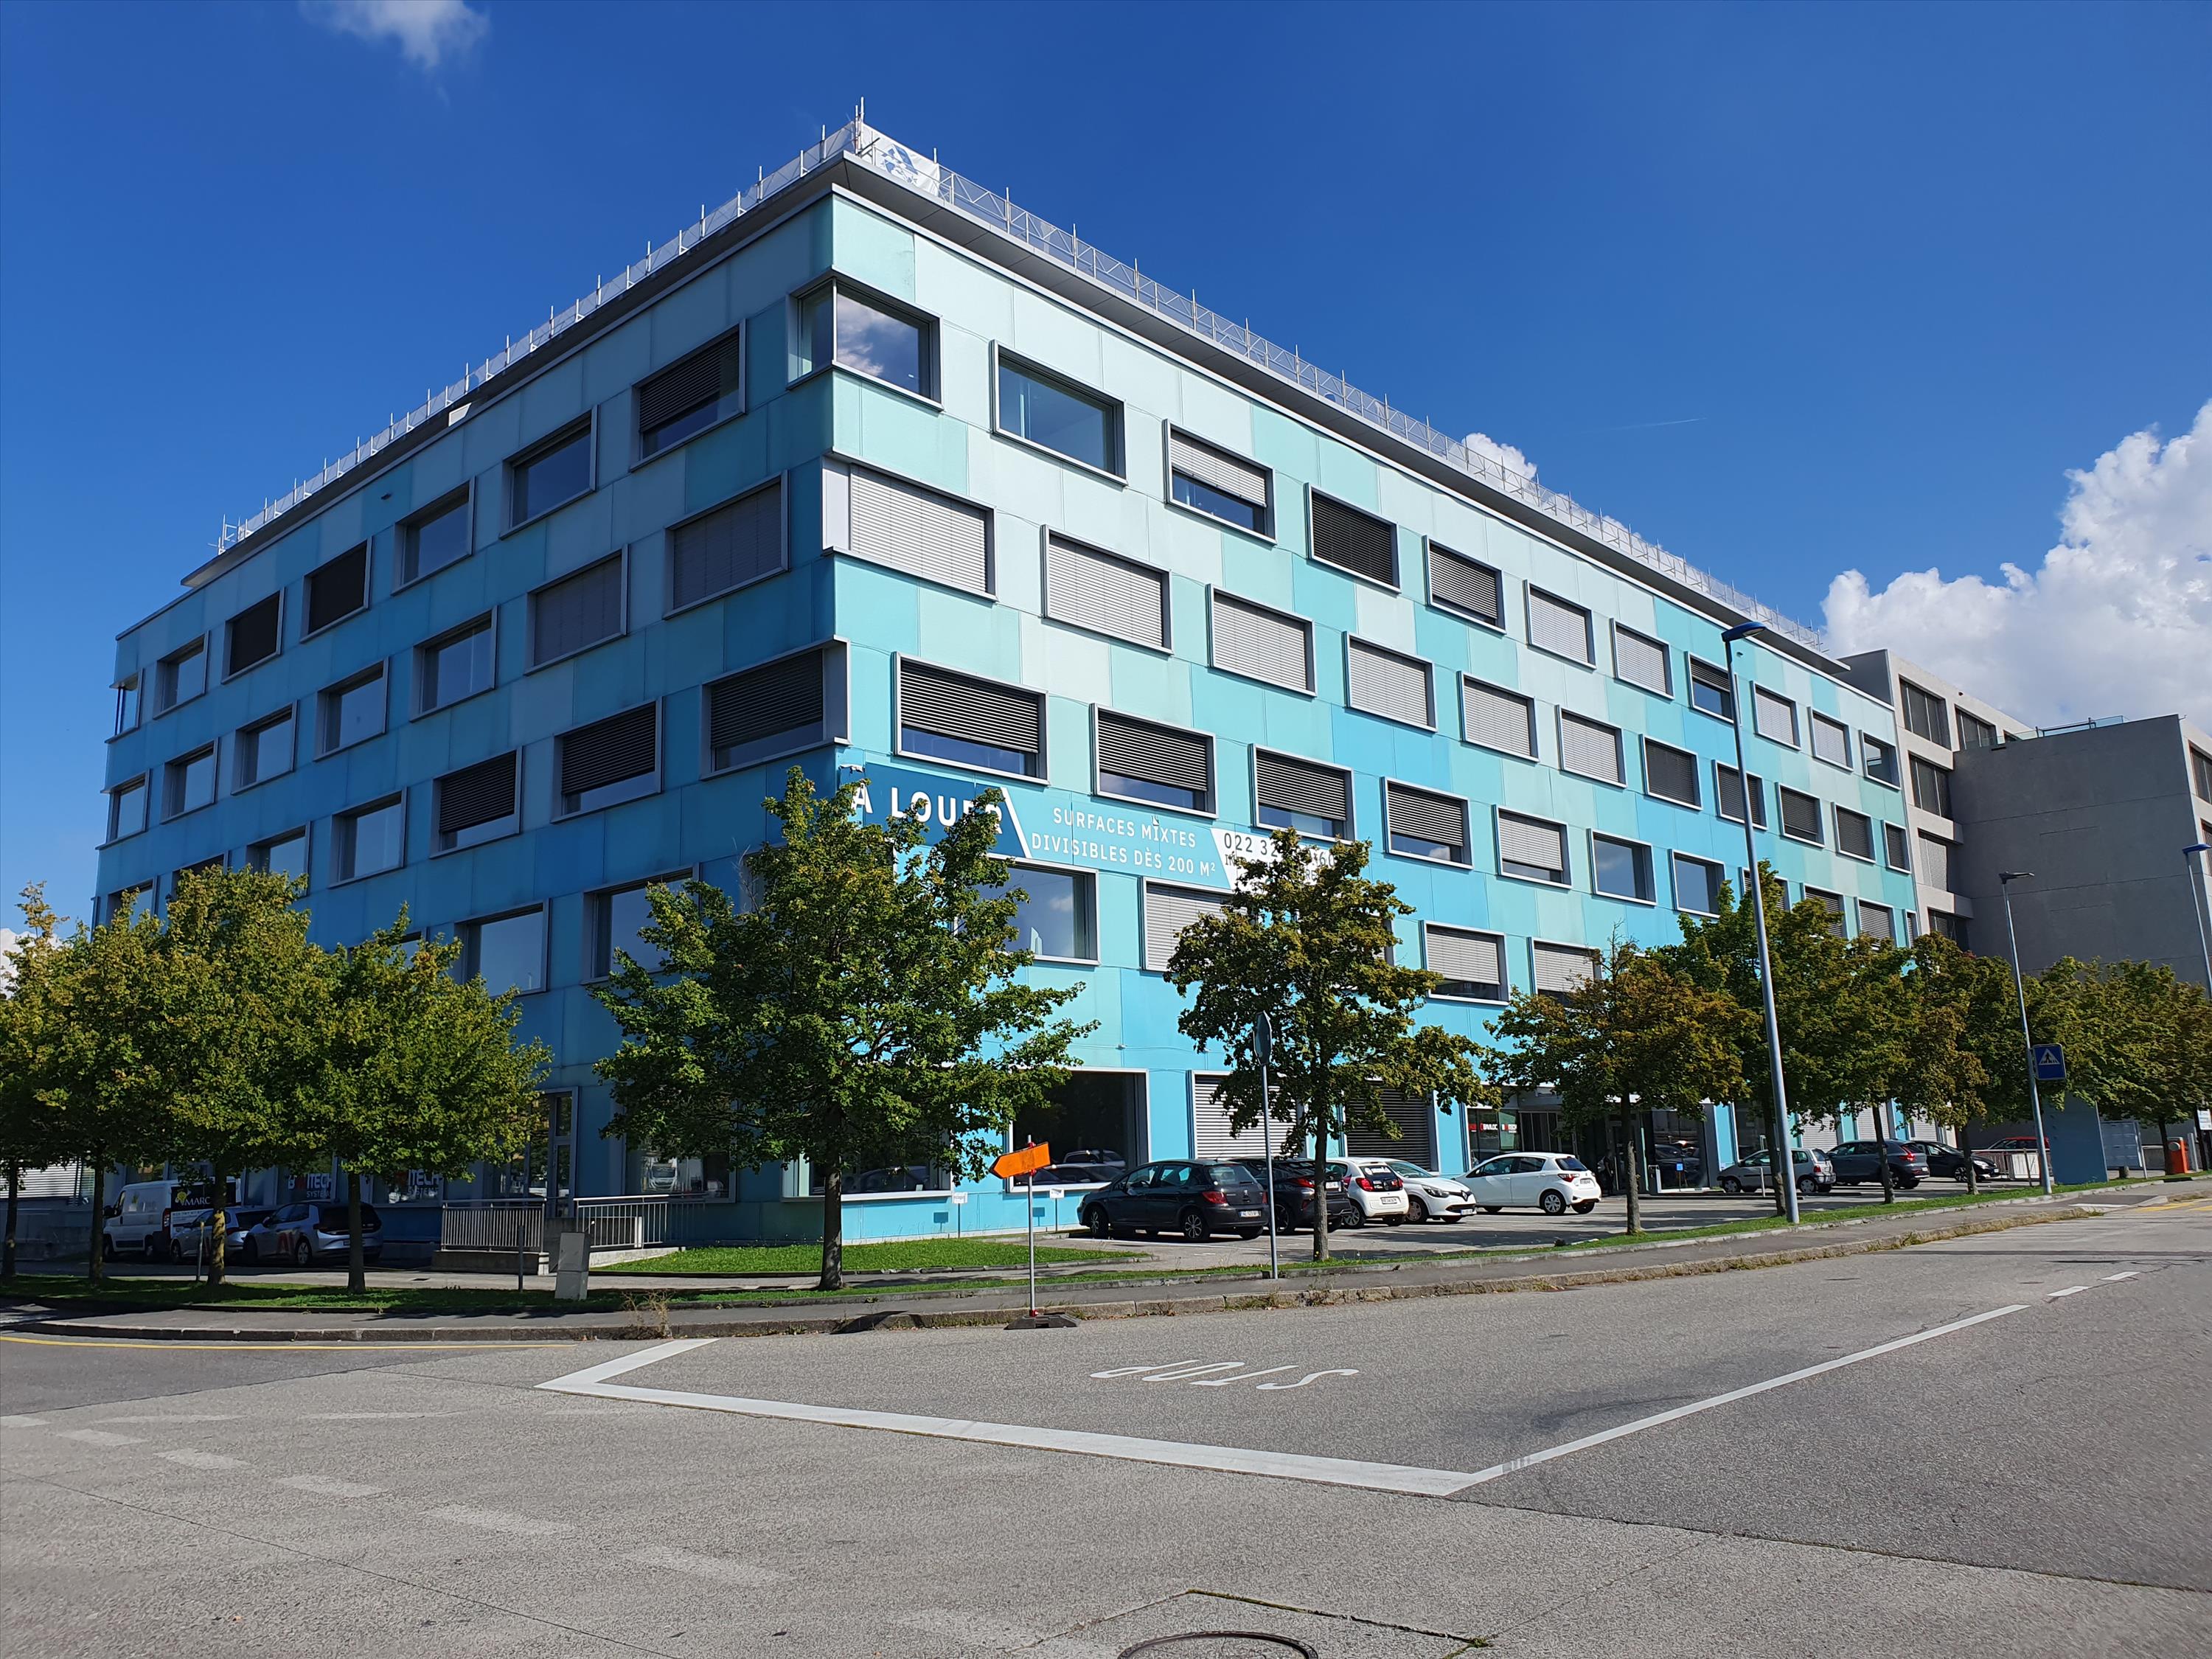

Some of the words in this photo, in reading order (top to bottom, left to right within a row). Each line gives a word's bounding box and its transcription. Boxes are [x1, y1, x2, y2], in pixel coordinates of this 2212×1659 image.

[1053, 807, 1135, 838] SURFACES
[1141, 824, 1197, 849] MIXTES
[1224, 832, 1253, 854] 022
[1032, 832, 1128, 863] DIVISIBLES
[1133, 847, 1163, 869] DÈS
[1167, 855, 1194, 874] 200
